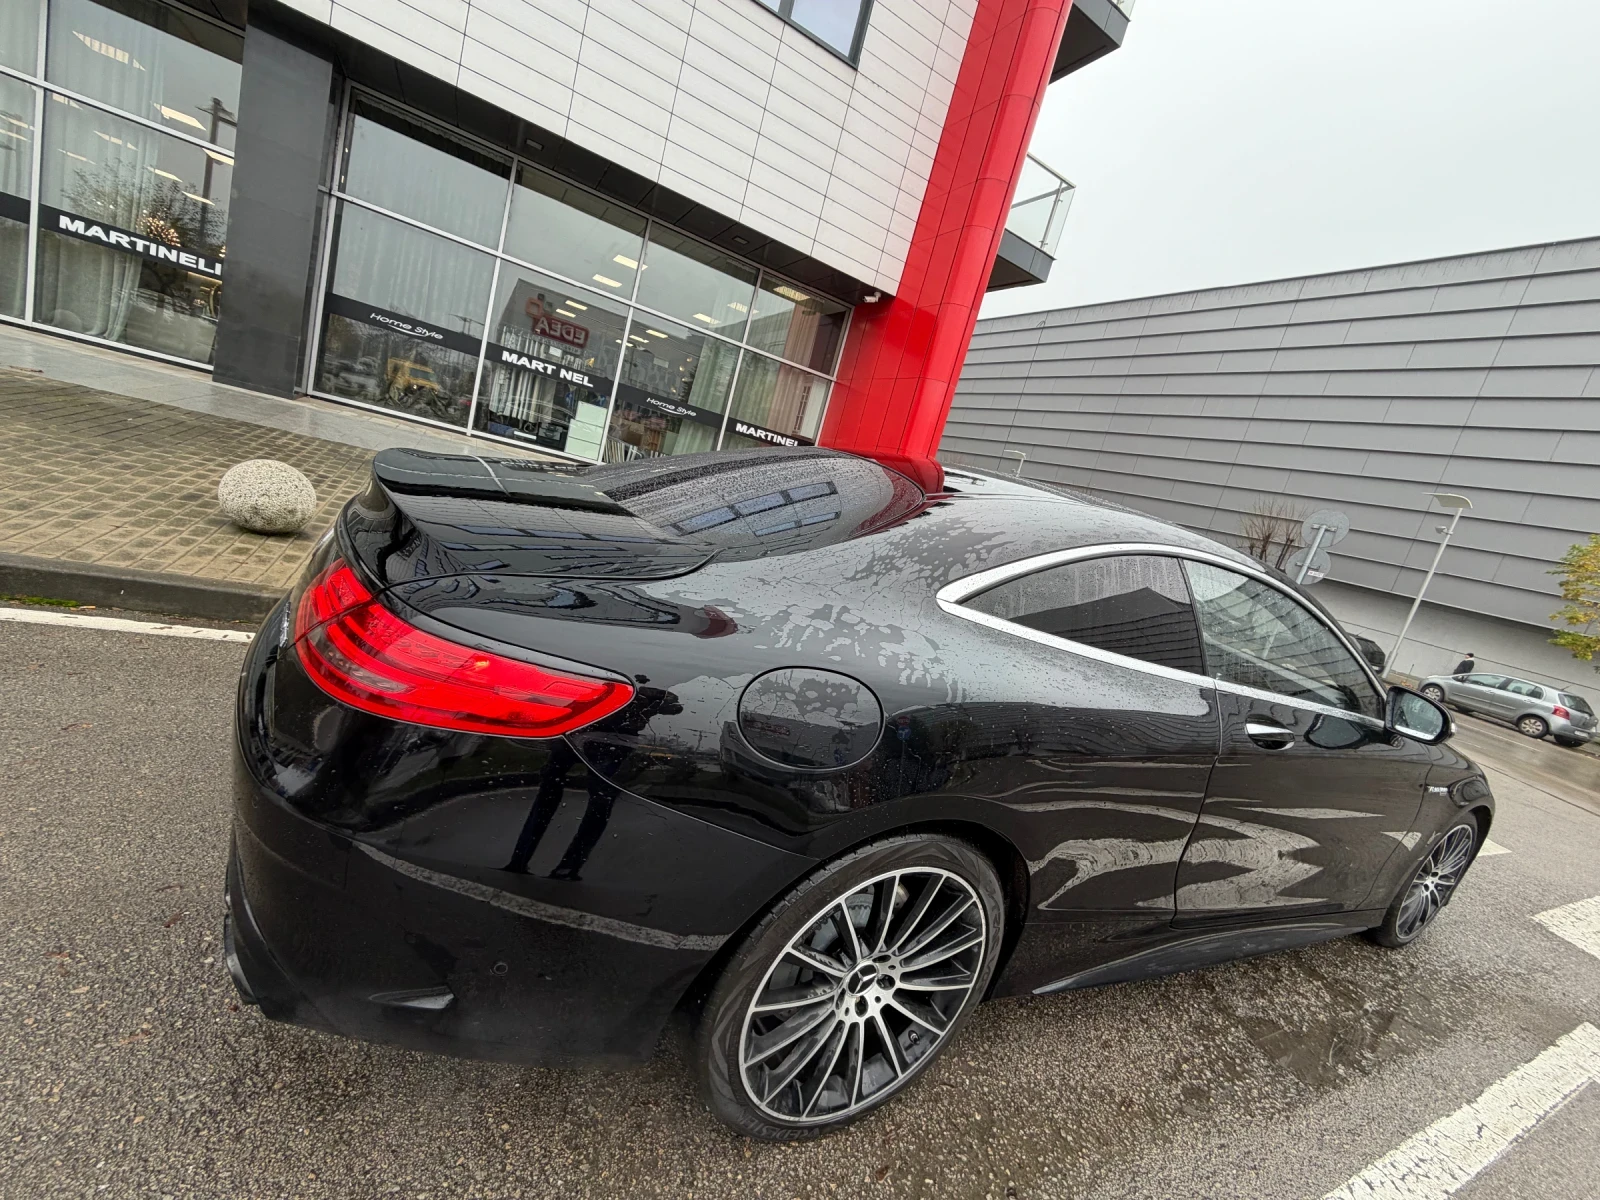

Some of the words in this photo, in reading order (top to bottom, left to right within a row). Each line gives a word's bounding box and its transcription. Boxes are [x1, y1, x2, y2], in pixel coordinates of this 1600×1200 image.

[369, 312, 412, 330] Home
[414, 325, 444, 341] Style
[646, 397, 675, 410] Home
[676, 405, 697, 417] Style
